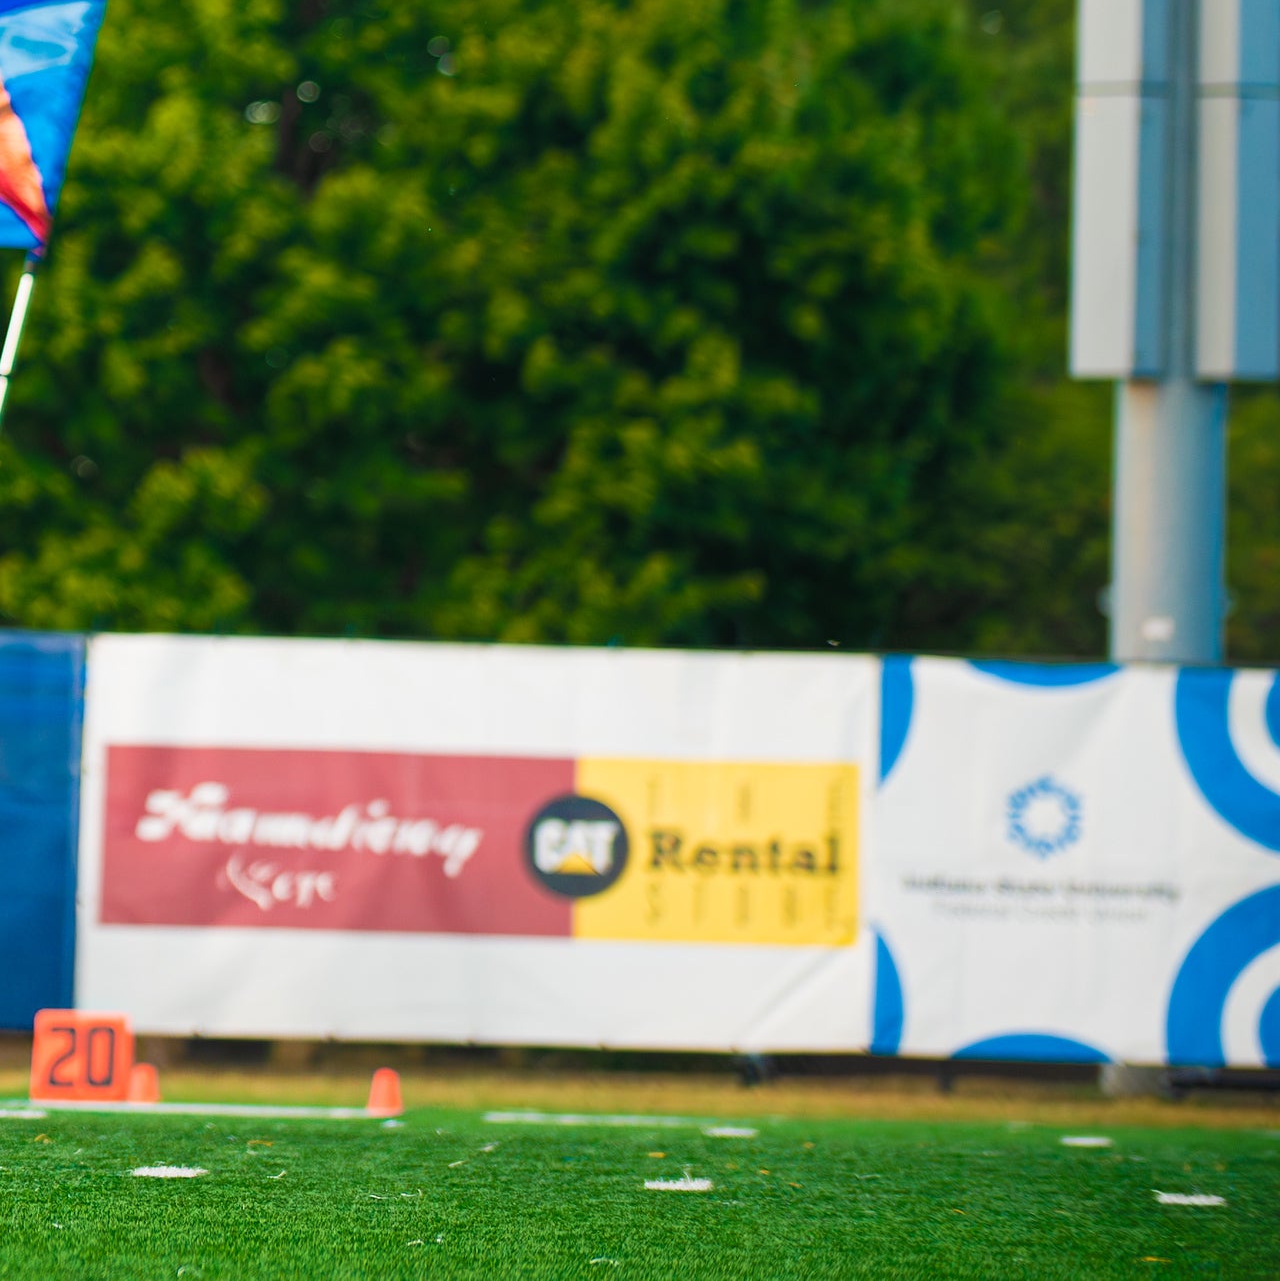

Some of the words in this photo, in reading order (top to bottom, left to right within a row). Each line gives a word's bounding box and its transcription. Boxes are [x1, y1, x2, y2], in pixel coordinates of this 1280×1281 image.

[533, 818, 621, 876] CAT
[646, 826, 841, 875] Rental
[48, 1026, 116, 1087] 20
